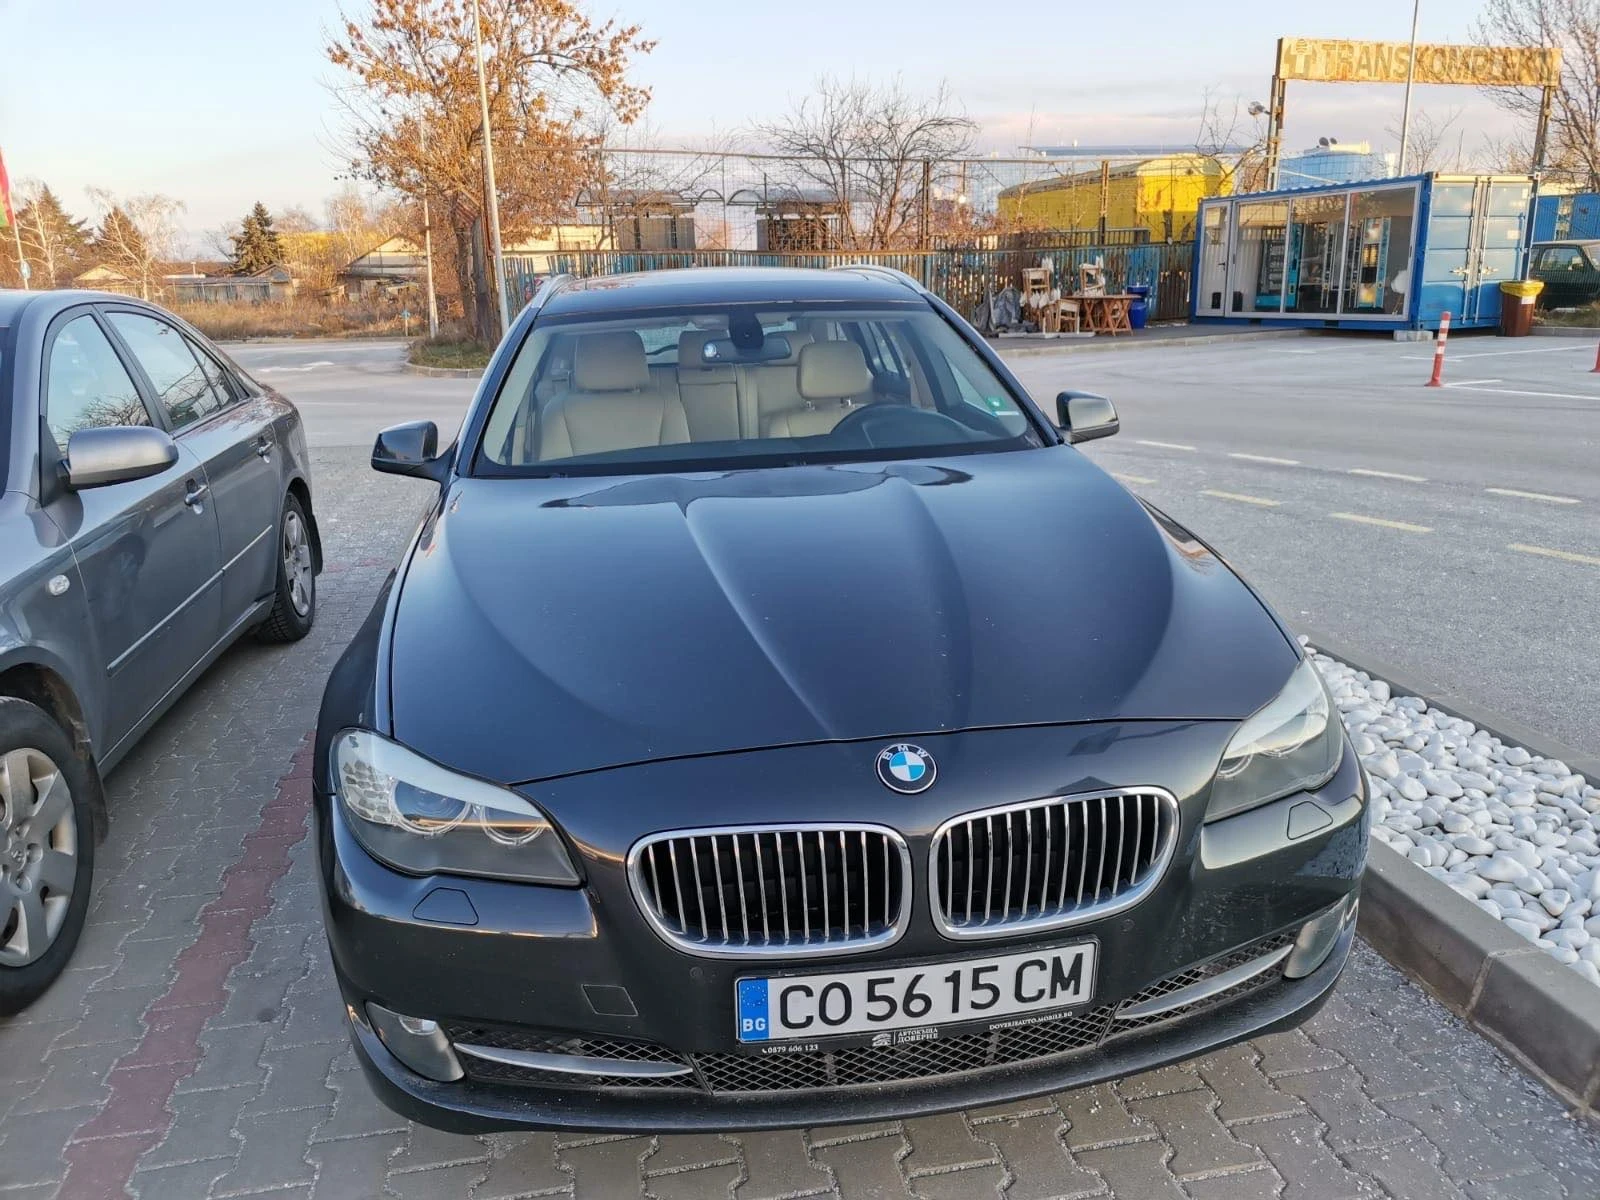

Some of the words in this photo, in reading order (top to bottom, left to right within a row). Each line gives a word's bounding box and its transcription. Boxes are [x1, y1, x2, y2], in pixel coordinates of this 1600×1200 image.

[882, 745, 928, 760] BMW
[780, 981, 852, 1029] CO
[866, 964, 1000, 1022] 5615
[1013, 952, 1084, 1004] CM
[742, 1017, 766, 1032] BG
[767, 1046, 786, 1054] 0879
